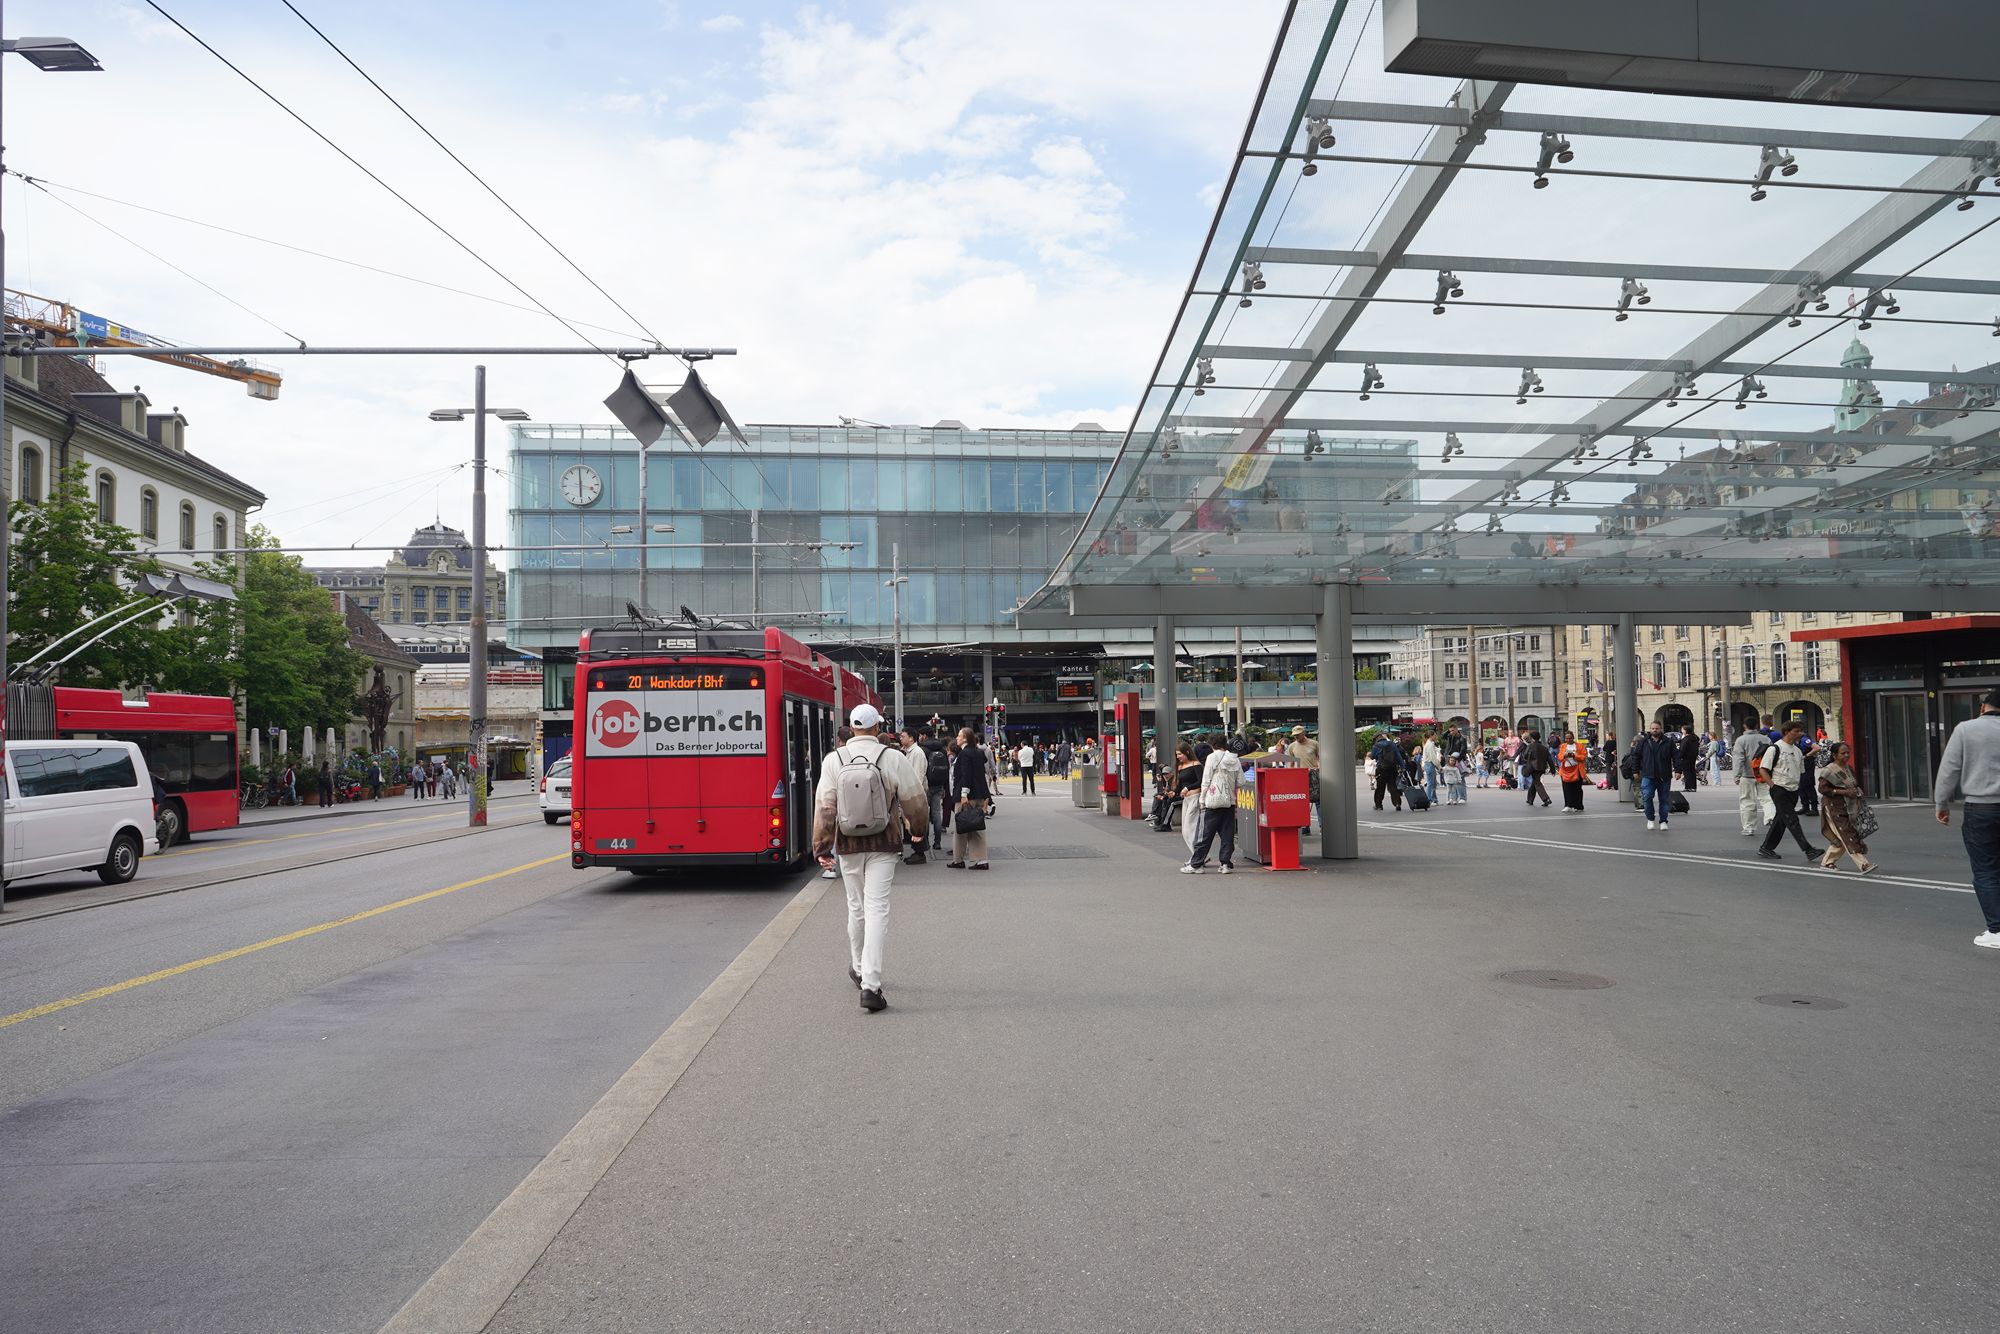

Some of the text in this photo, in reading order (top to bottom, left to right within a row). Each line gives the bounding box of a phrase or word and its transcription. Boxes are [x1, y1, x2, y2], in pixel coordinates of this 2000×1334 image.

[658, 638, 697, 649] HESS
[628, 675, 724, 689] 20 Wankdorf Bhf
[656, 741, 763, 752] Das Berner Jobportal
[610, 838, 628, 850] 44
